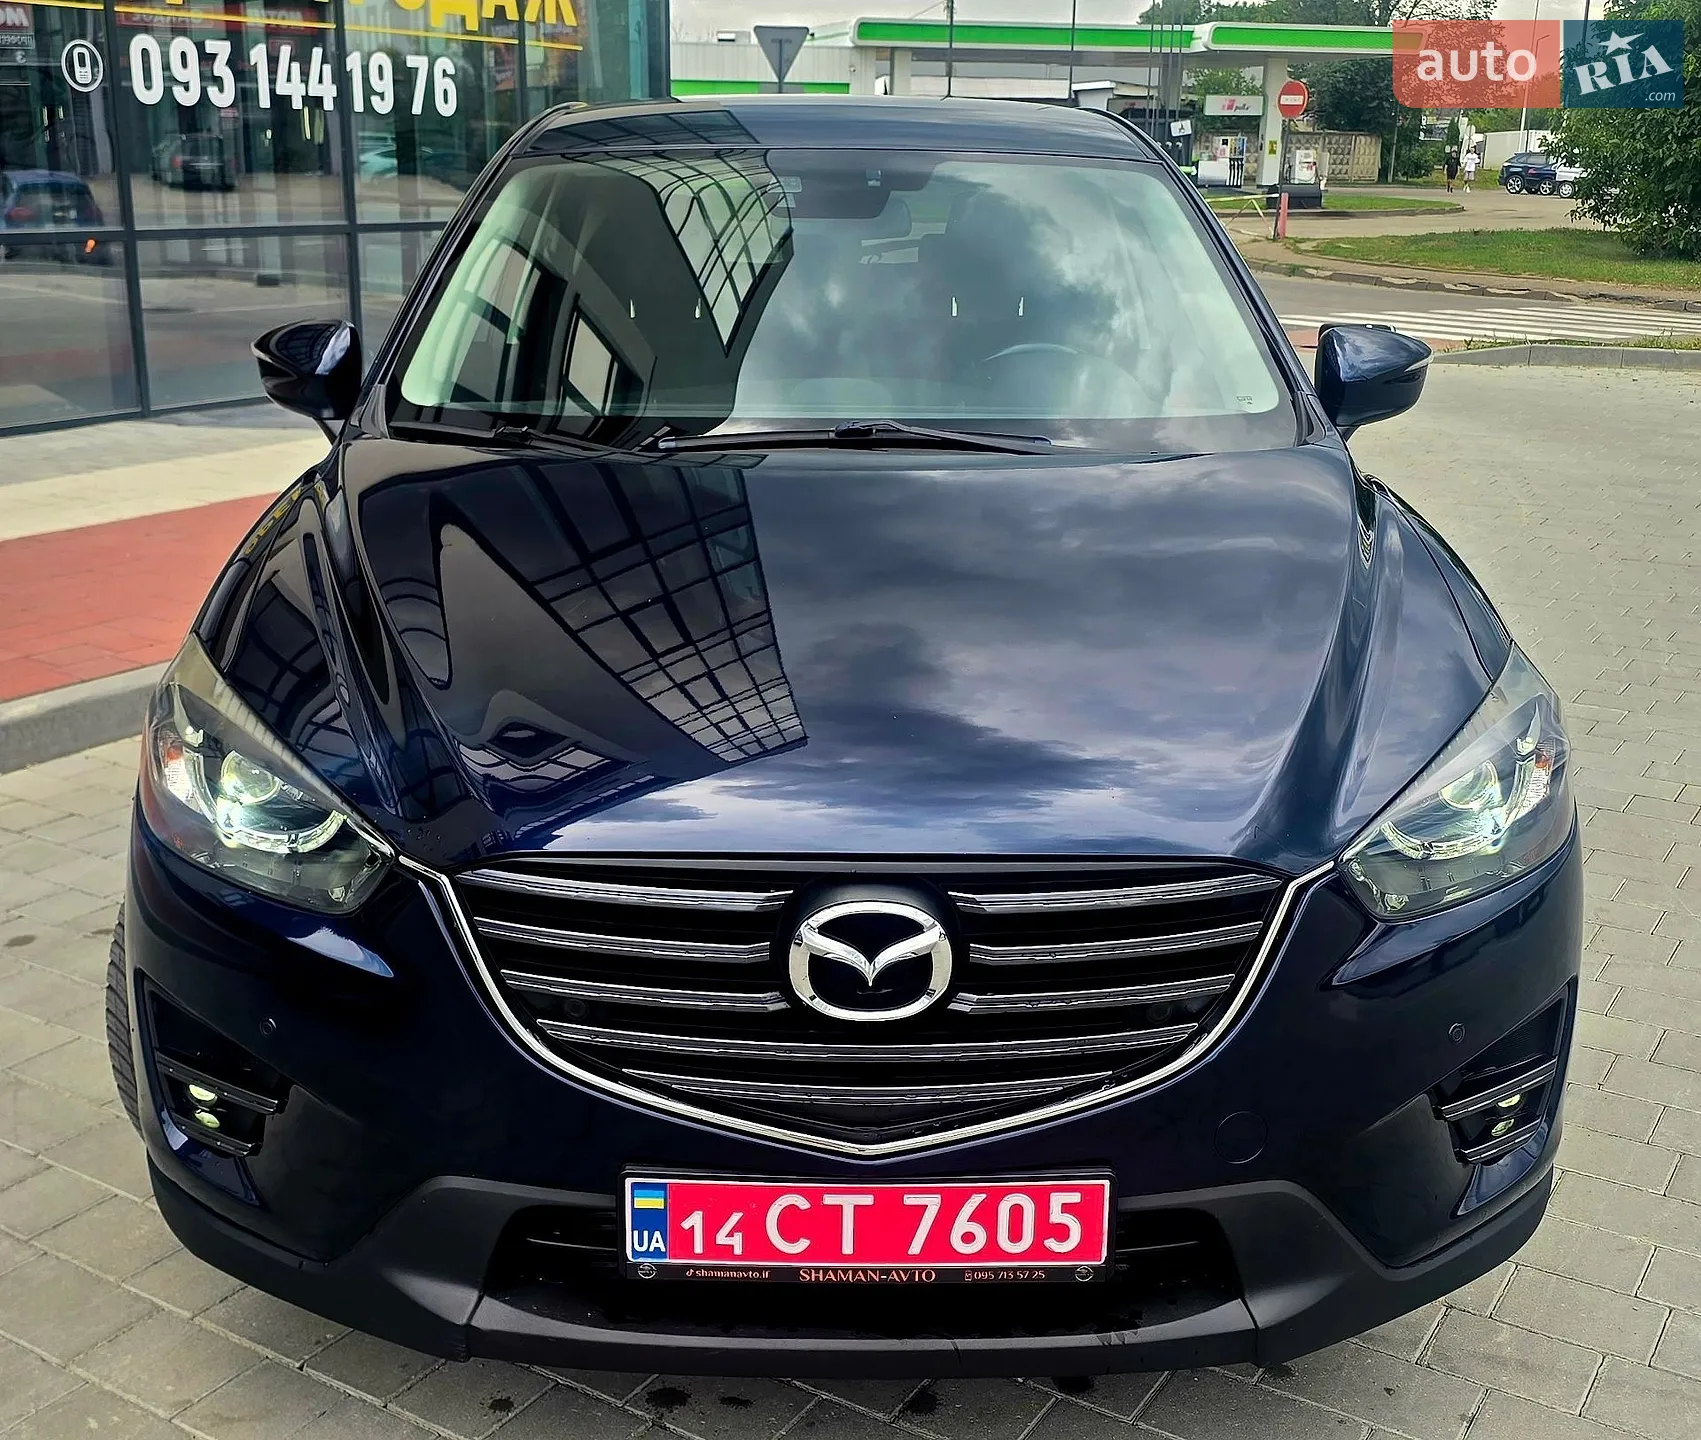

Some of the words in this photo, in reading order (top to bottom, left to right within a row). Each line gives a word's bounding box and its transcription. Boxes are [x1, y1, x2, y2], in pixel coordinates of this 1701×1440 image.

[129, 33, 236, 108] 093
[250, 43, 338, 112] 144
[345, 50, 394, 115] 19
[406, 54, 458, 118] 76
[680, 1210, 744, 1256] 14
[903, 1192, 1082, 1256] 7605
[633, 1230, 666, 1253] UA
[799, 1268, 936, 1283] SHAMAN-AVTO
[974, 1270, 995, 1280] 095
[998, 1270, 1014, 1280] 713
[1017, 1270, 1029, 1280] 57
[1031, 1270, 1046, 1280] 25
